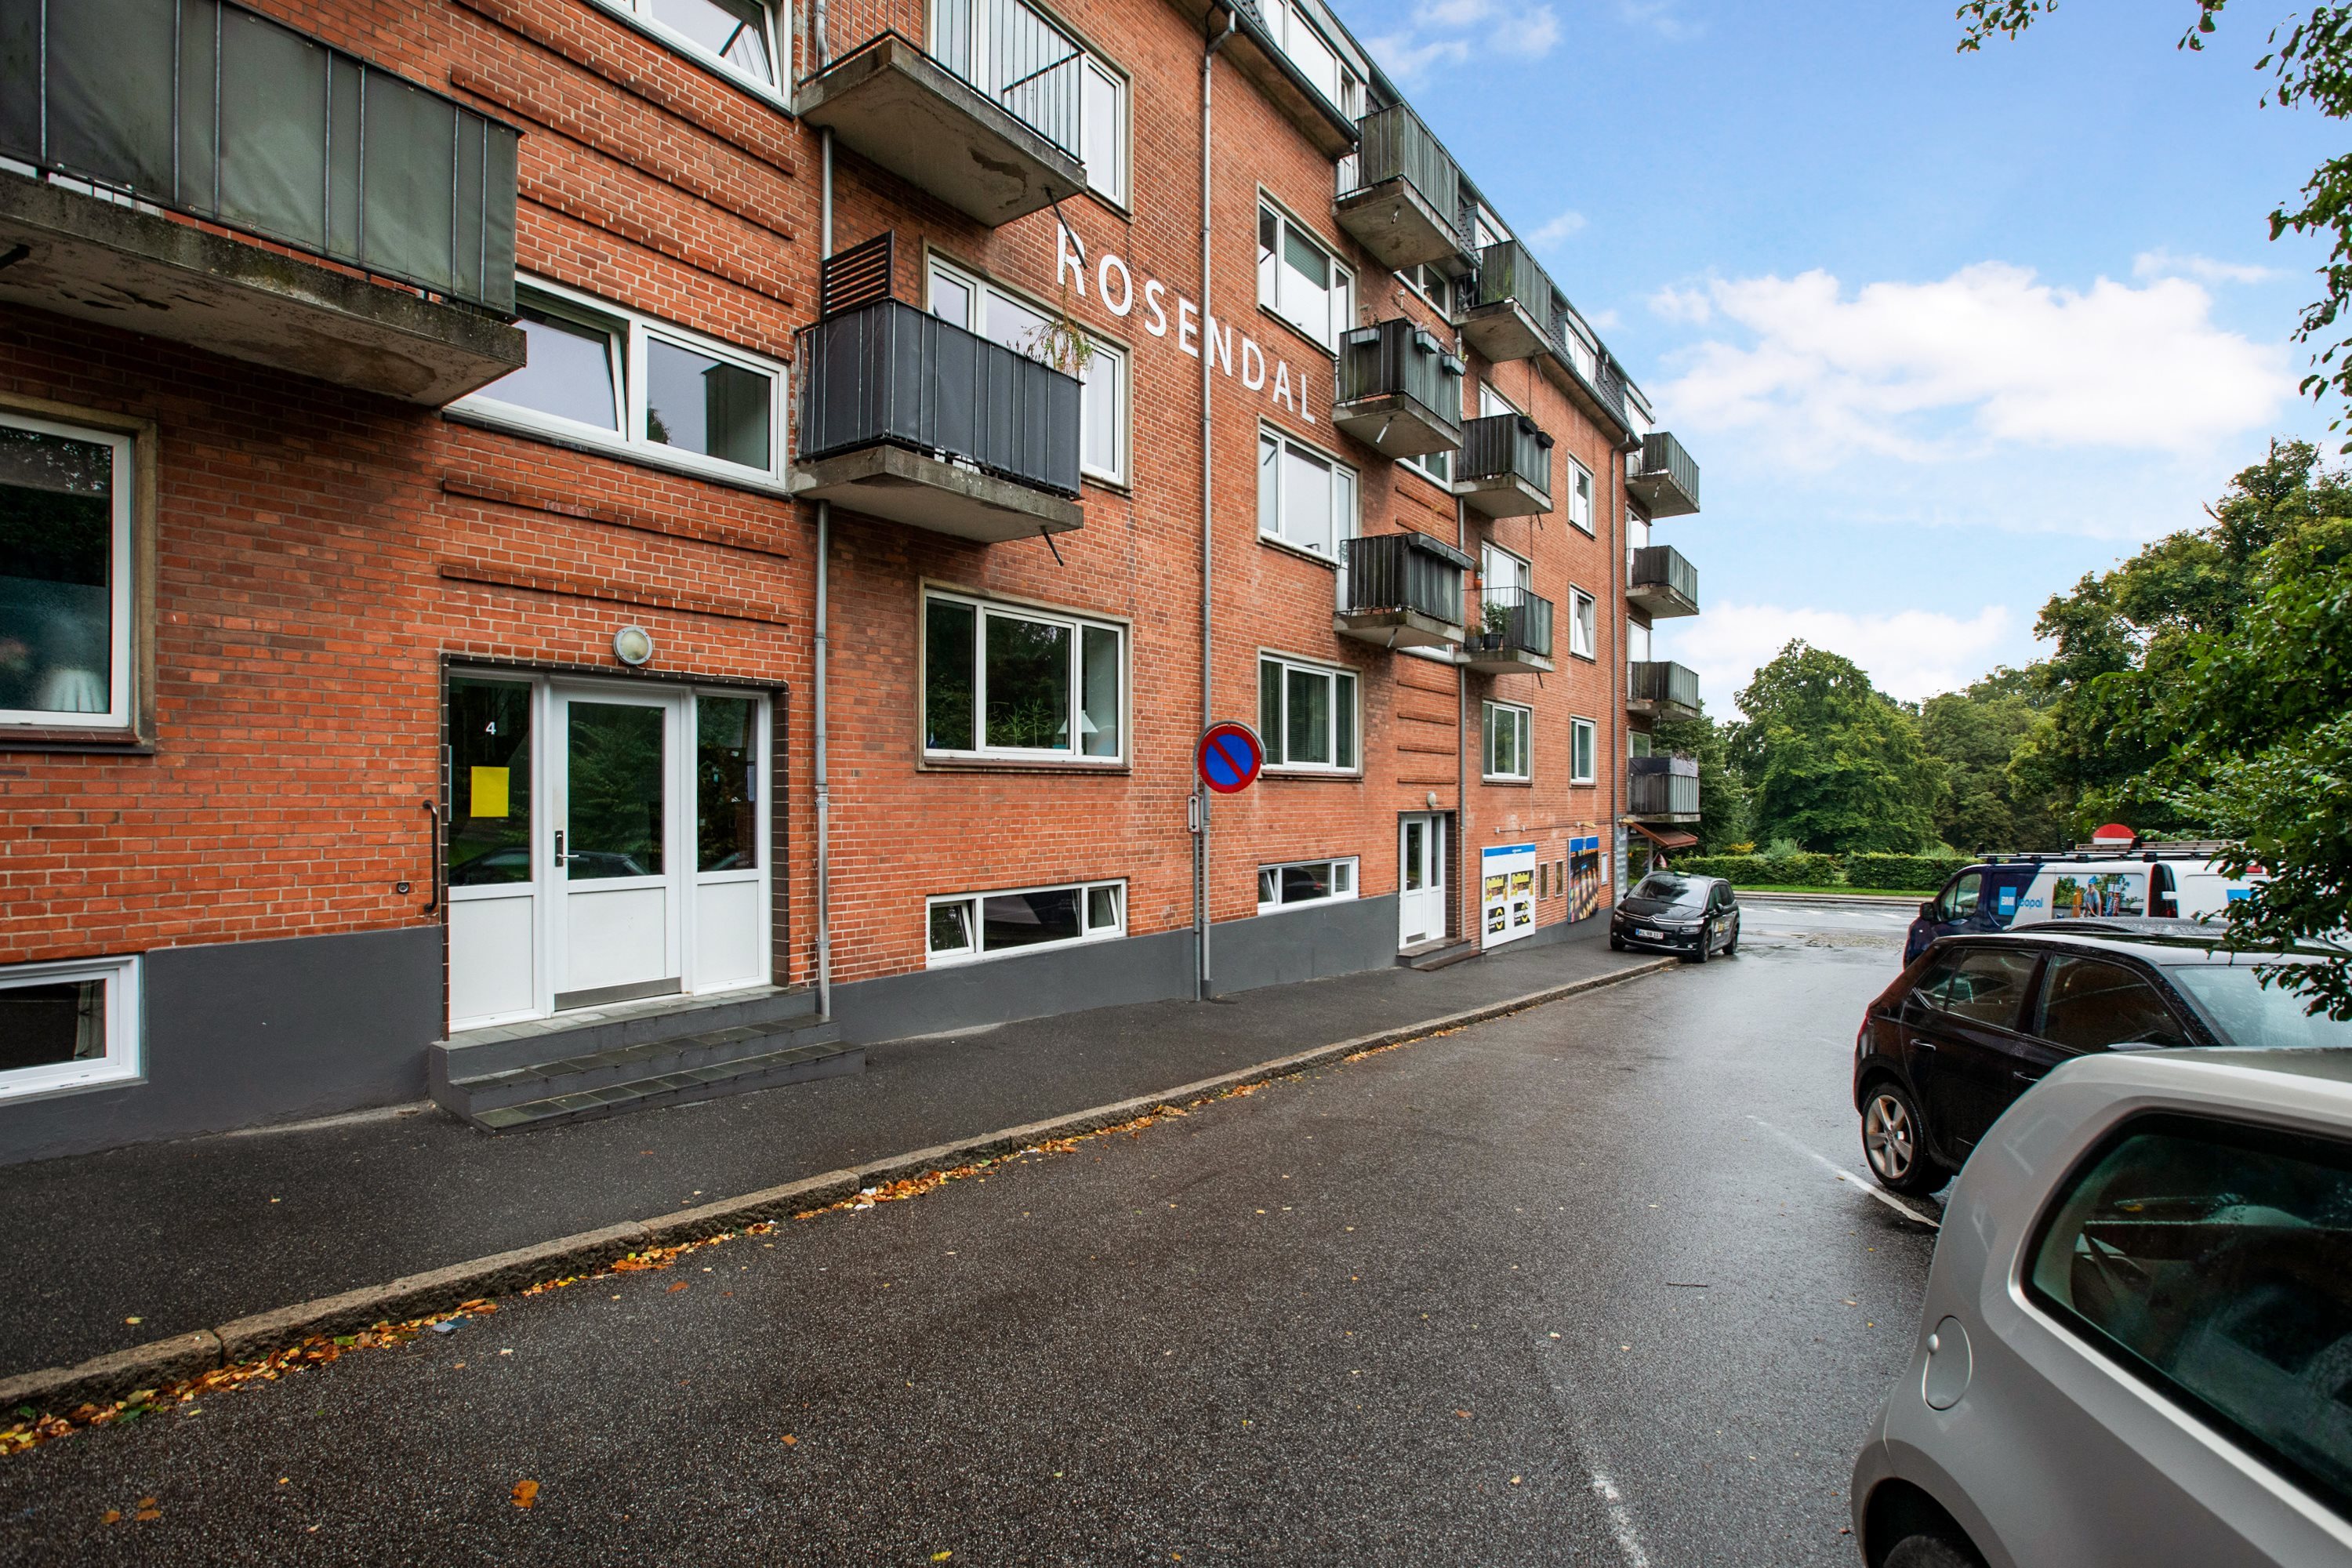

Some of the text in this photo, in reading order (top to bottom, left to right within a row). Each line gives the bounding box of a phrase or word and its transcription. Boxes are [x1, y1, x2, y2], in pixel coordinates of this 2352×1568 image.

[1056, 223, 1316, 425] ROSENDAL
[485, 721, 497, 735] 4
[2001, 896, 2015, 906] BMI
